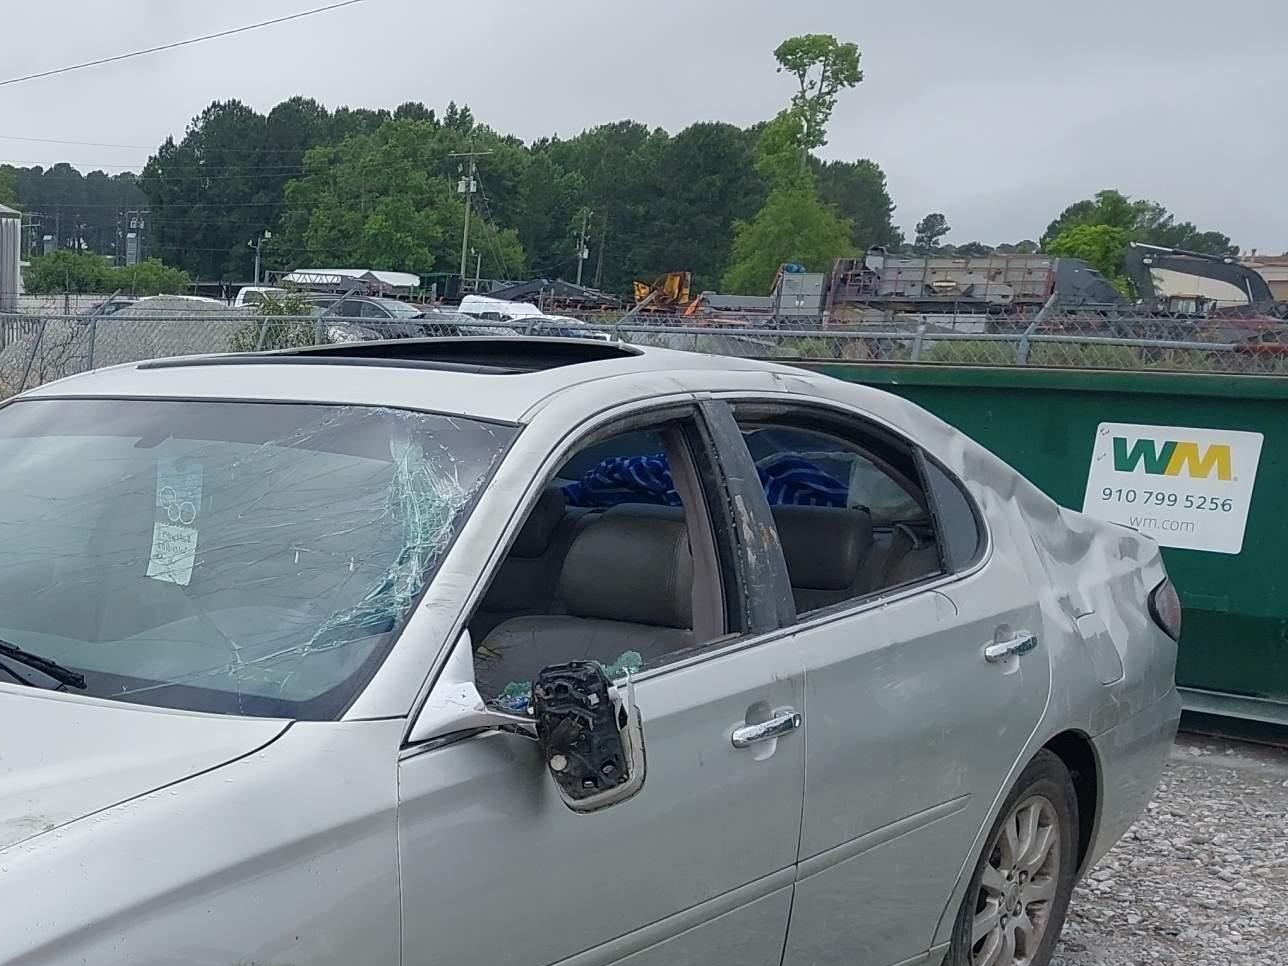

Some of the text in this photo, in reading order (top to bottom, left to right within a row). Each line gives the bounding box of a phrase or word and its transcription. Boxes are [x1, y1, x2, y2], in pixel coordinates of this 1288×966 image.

[1112, 436, 1232, 481] WM
[1102, 487, 1233, 512] 910 799 5256
[1129, 515, 1195, 532] wm.com
